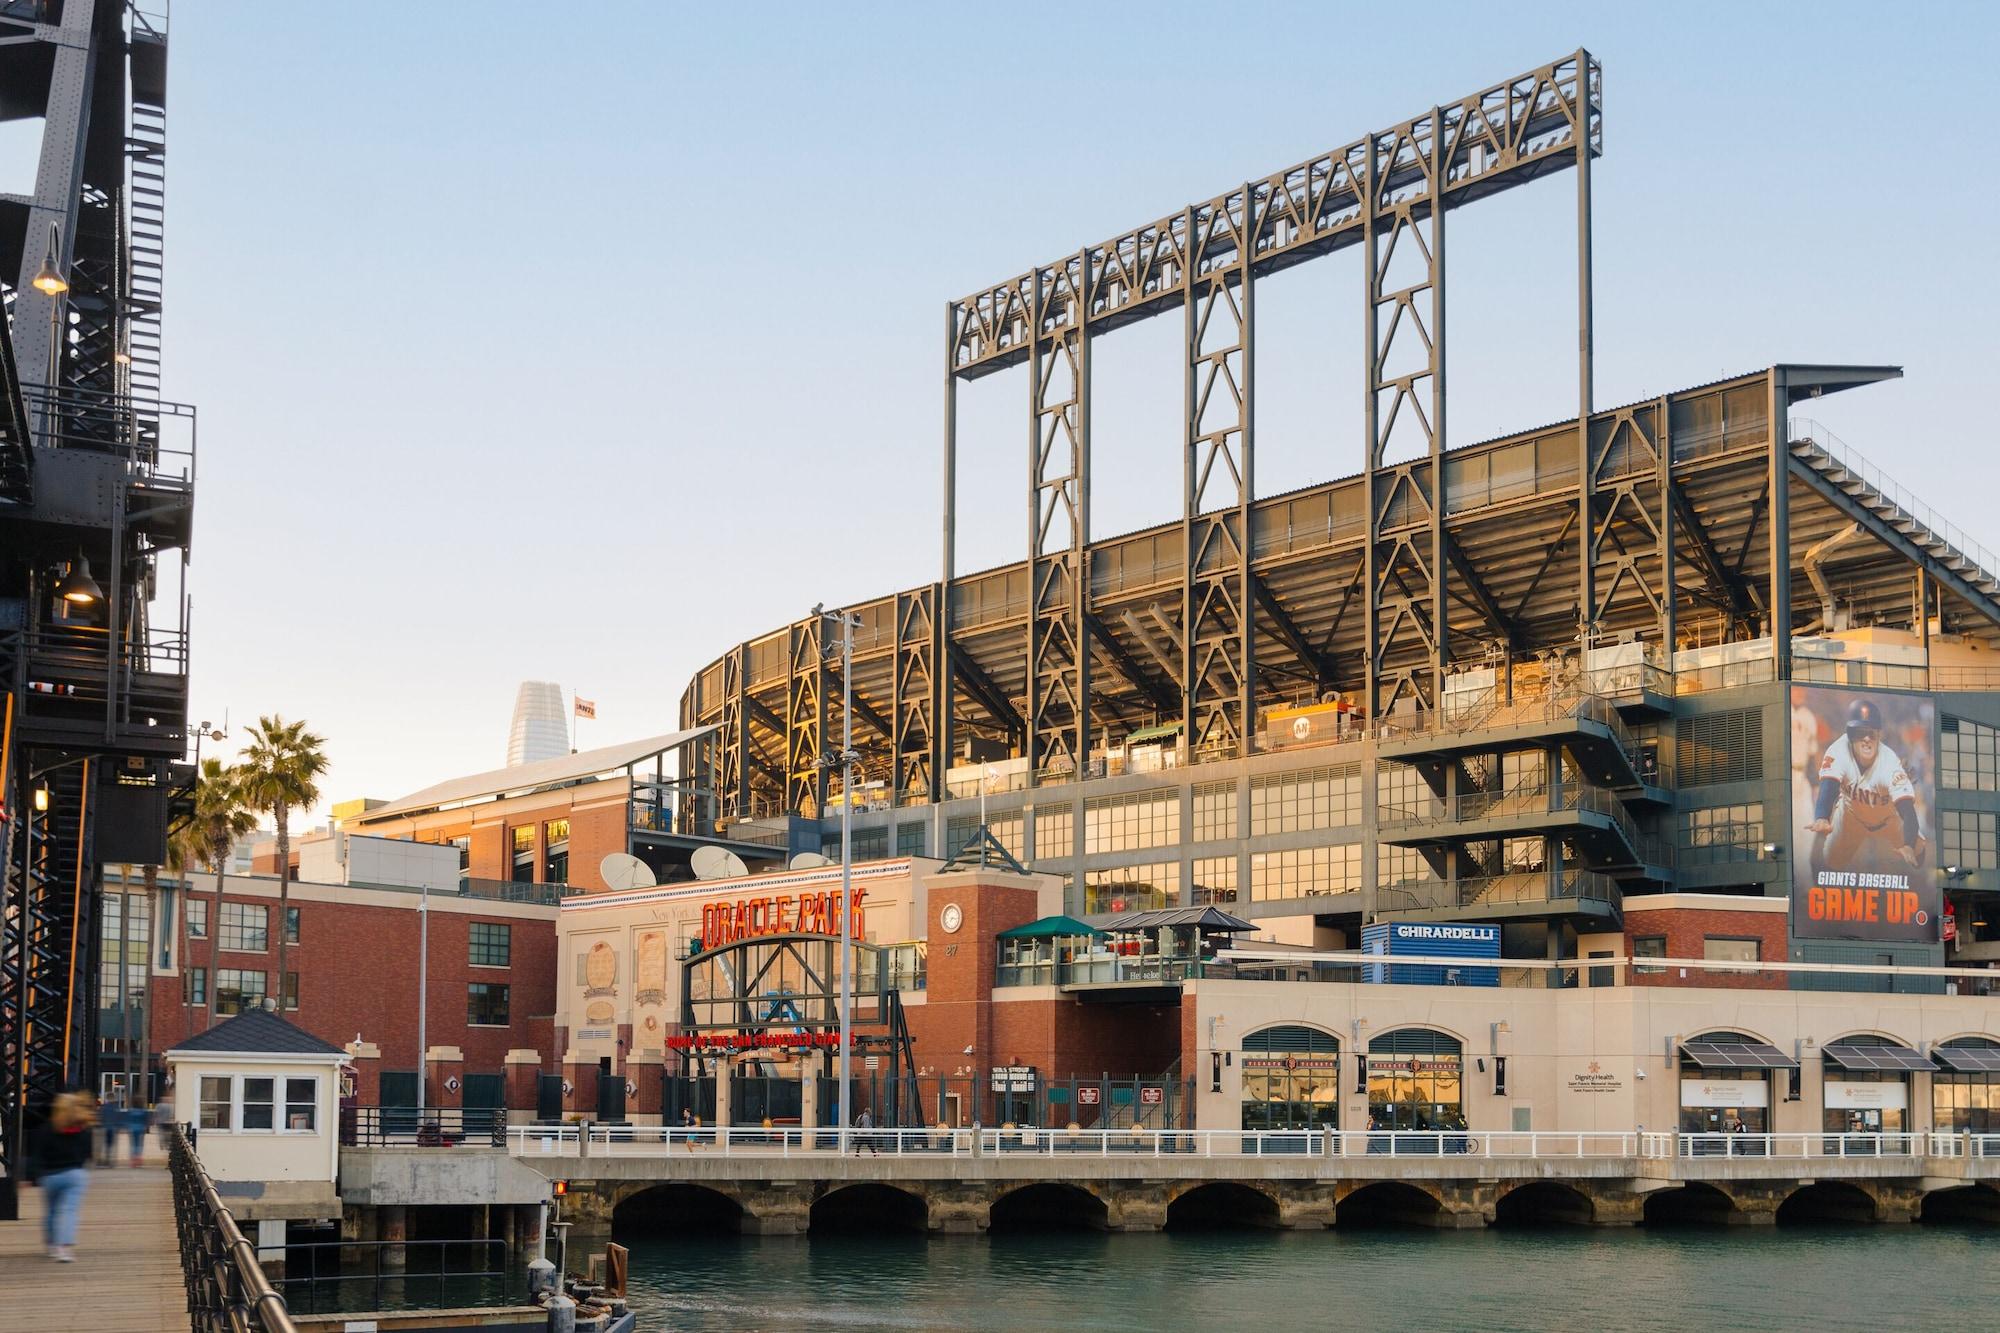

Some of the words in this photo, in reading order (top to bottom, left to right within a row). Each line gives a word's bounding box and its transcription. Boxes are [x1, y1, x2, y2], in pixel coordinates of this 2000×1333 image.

[1817, 871, 1857, 887] GIANTS
[1858, 873, 1909, 889] BASEBALL
[1808, 887, 1880, 922] GAME
[702, 896, 792, 952] ORACLE
[799, 888, 866, 942] PARK
[1397, 926, 1494, 940] GHIRARDELLI
[731, 1034, 751, 1048] SAN
[815, 1031, 856, 1047] GIANS
